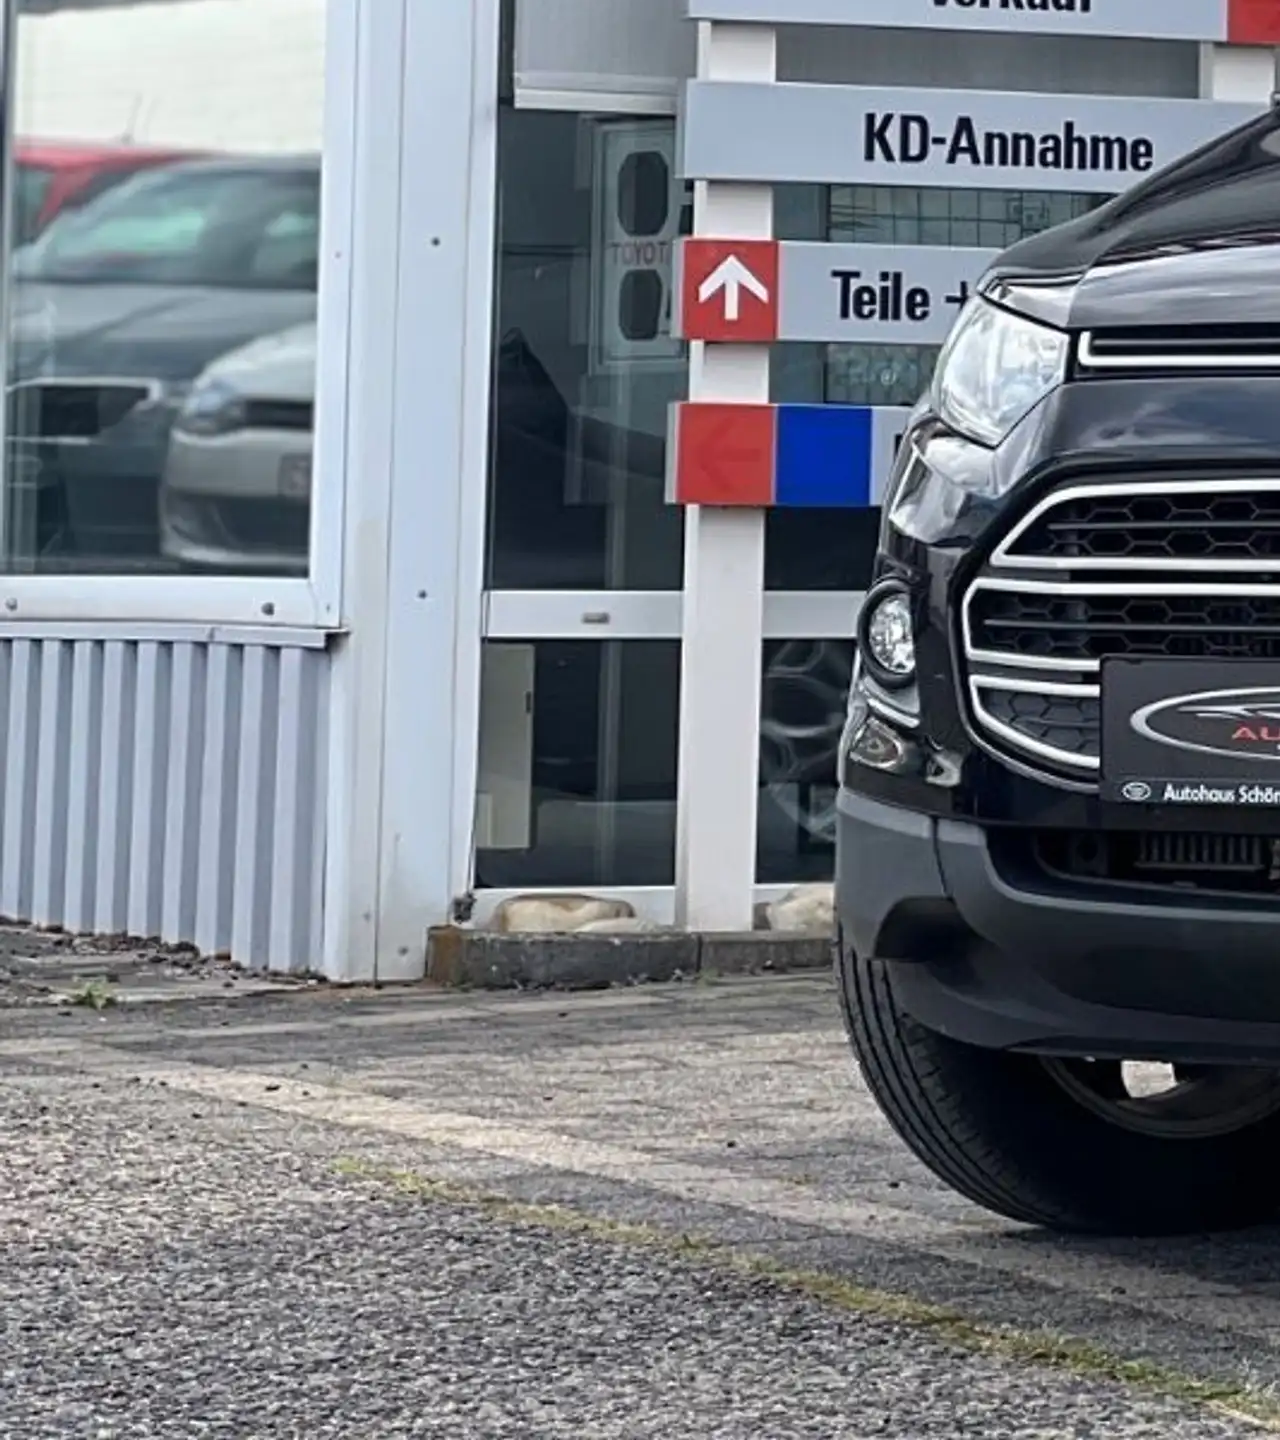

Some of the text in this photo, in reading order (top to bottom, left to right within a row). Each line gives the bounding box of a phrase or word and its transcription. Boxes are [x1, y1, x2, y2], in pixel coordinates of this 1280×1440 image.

[864, 113, 1153, 172] KD-Annahme
[610, 240, 671, 265] TOYOT
[831, 270, 930, 321] Teile
[1163, 783, 1236, 803] Autohaus
